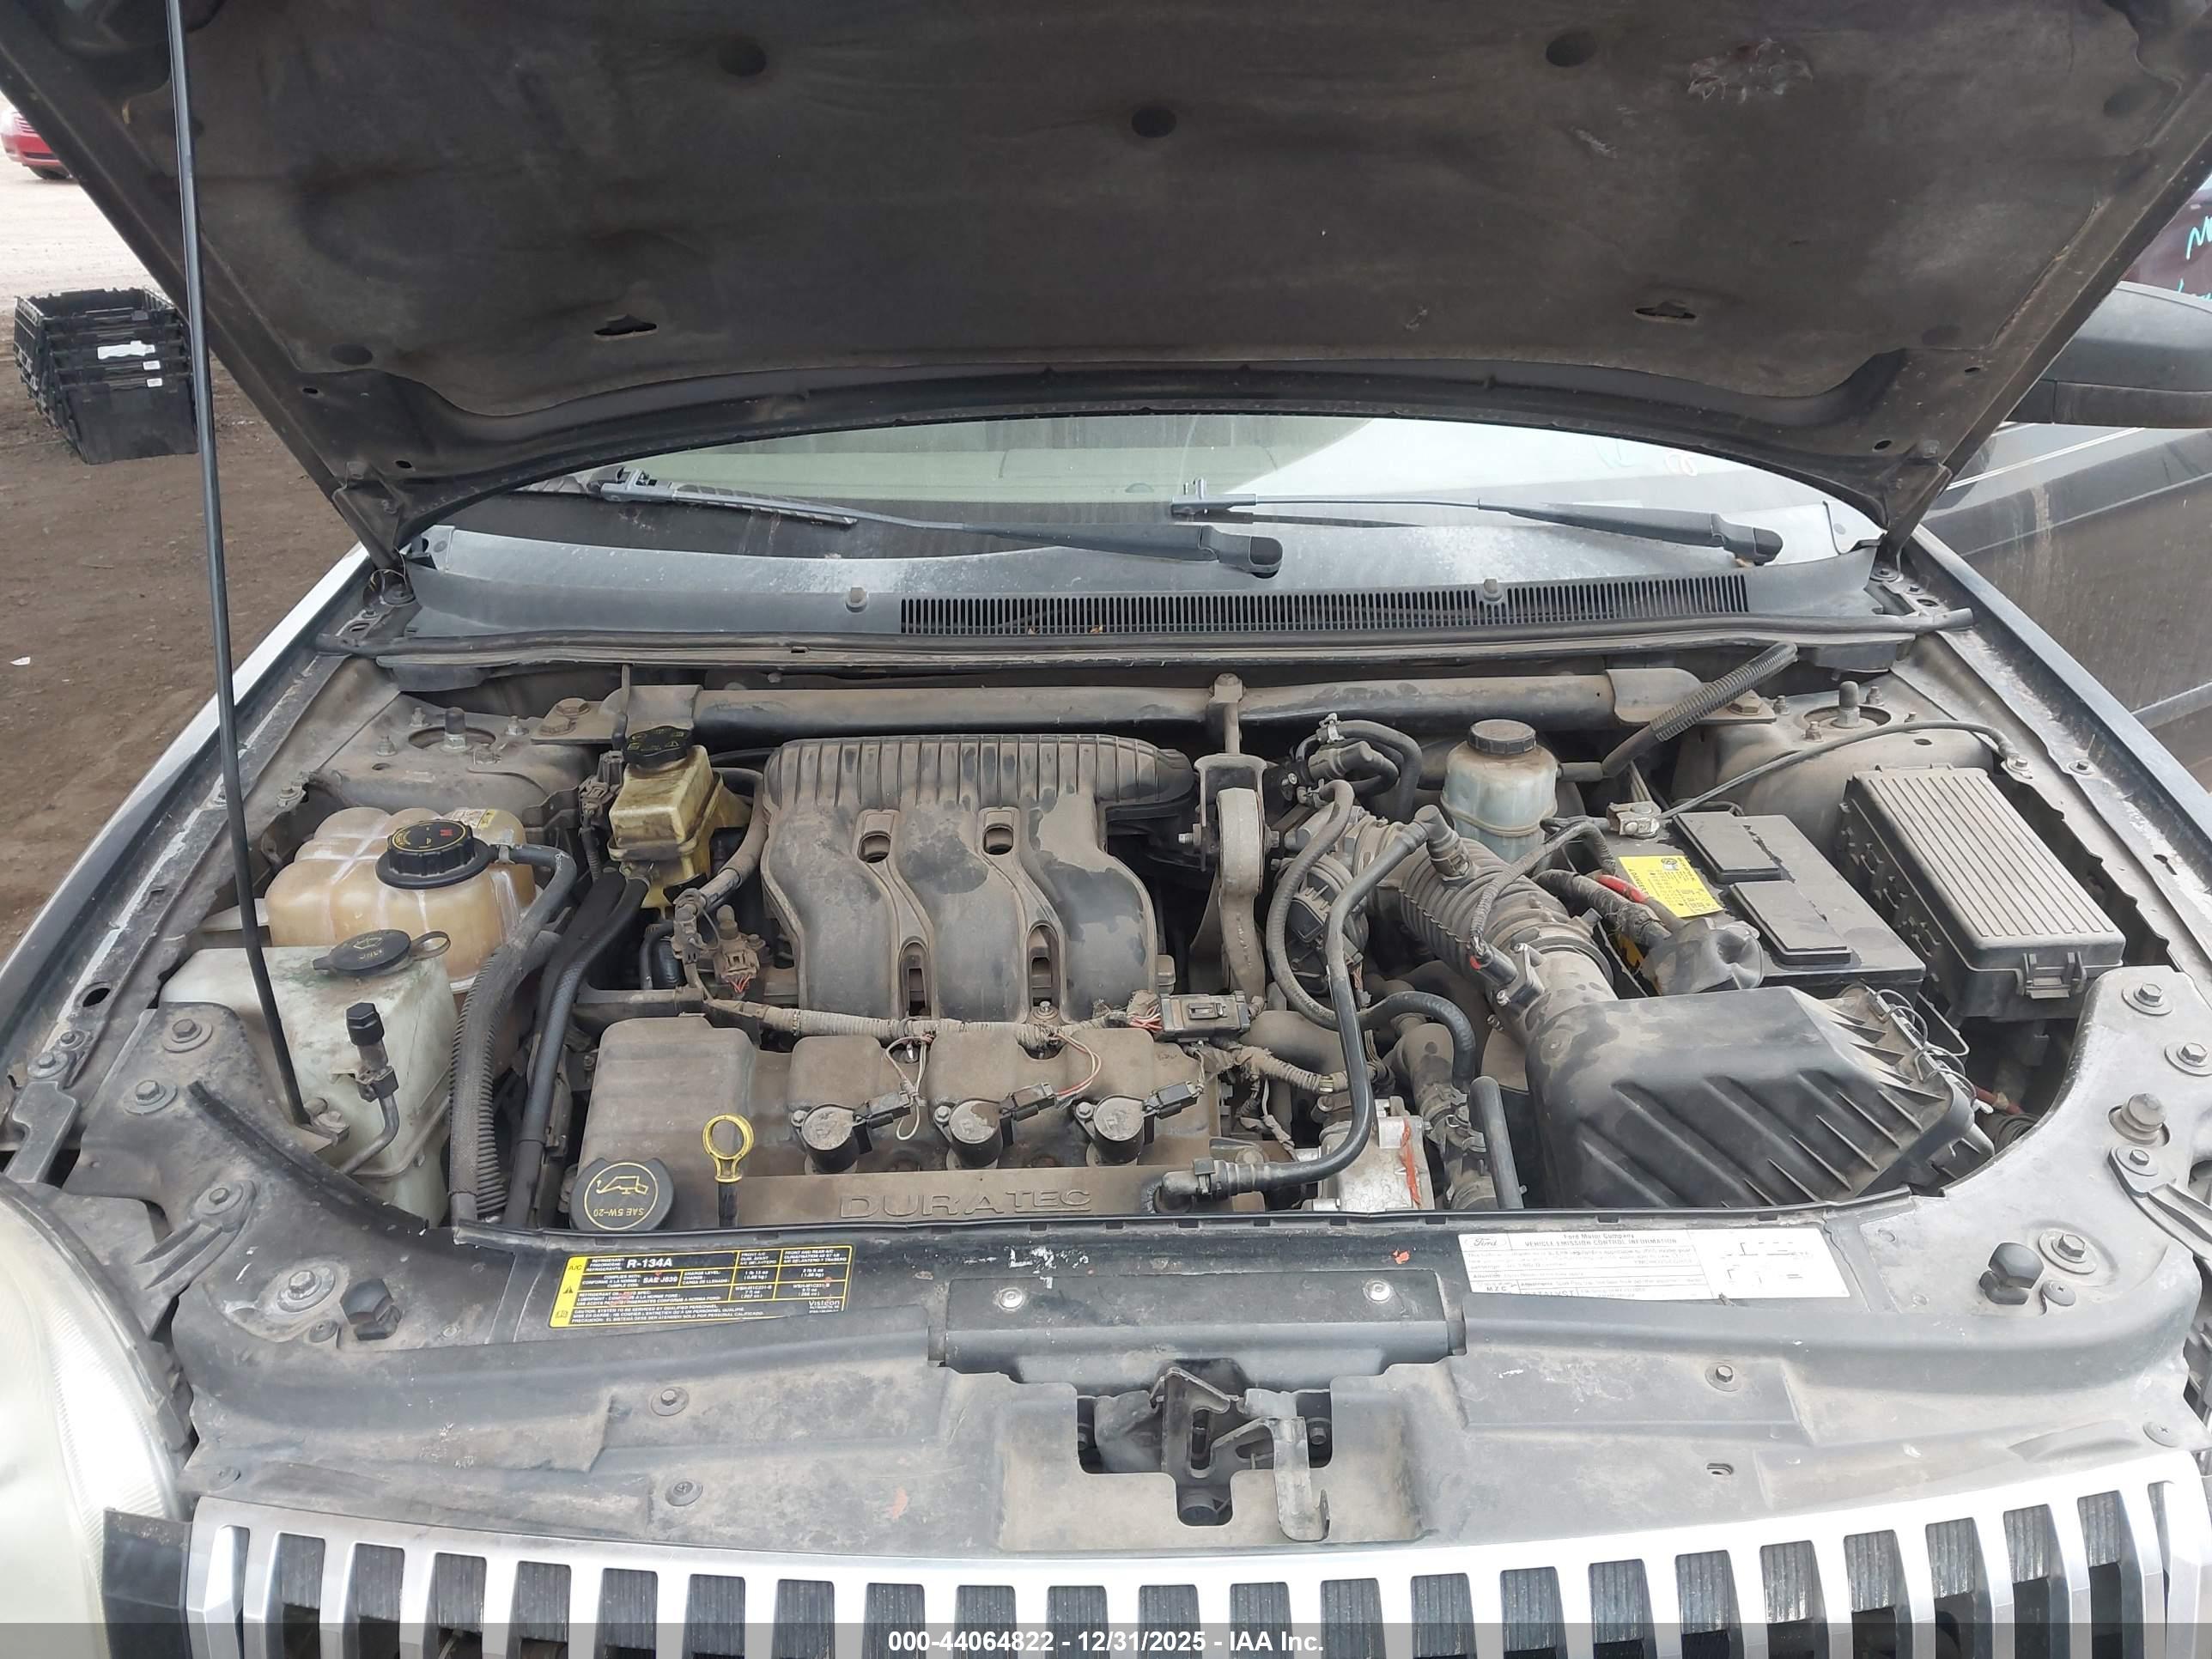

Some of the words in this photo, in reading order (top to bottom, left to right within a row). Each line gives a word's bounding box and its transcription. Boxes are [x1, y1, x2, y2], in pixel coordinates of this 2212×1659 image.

[840, 1189, 1091, 1217] DURATEC
[592, 1208, 624, 1217] 5W-20
[626, 1207, 645, 1216] SAE
[1472, 1238, 1498, 1247] Ford
[626, 1258, 672, 1268] R-134A
